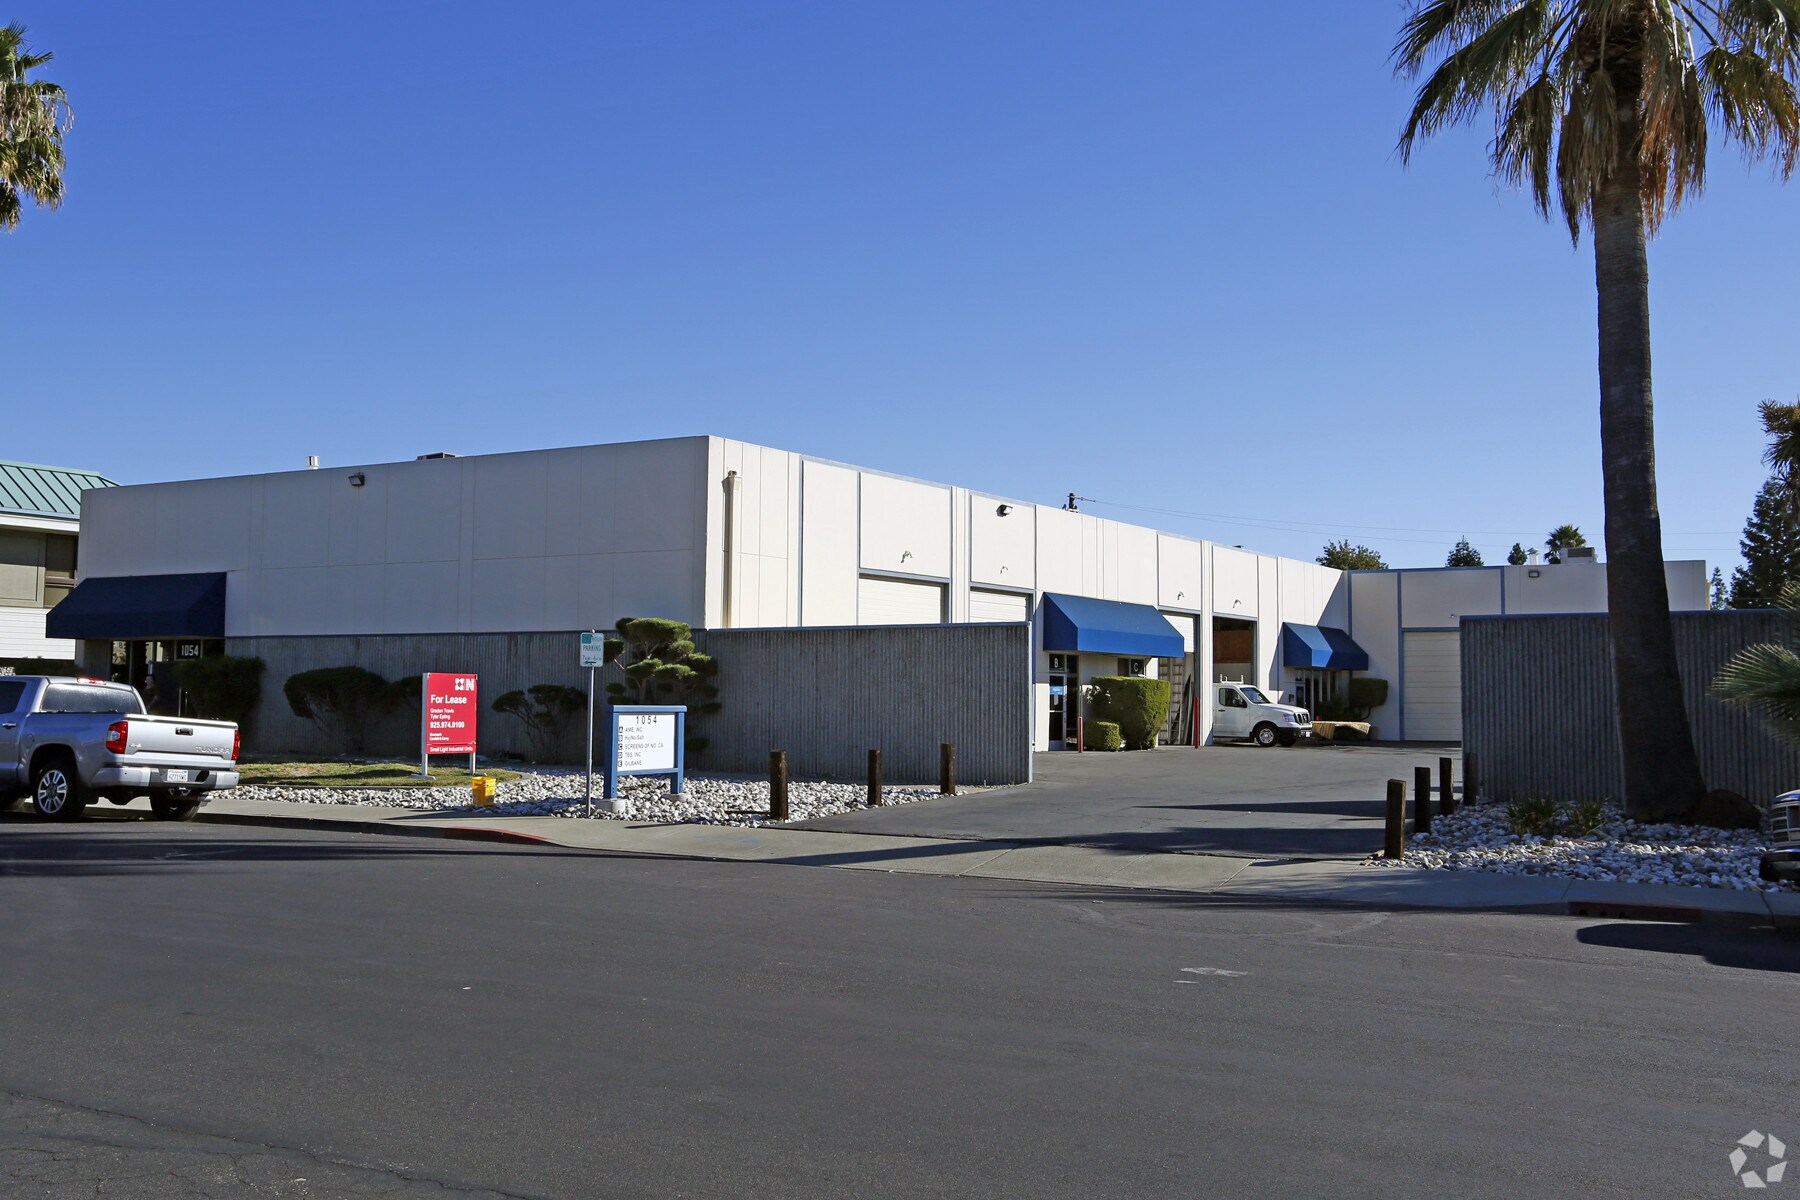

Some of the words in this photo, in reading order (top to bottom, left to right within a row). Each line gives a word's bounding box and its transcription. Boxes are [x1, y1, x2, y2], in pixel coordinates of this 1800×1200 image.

[181, 645, 199, 656] 1054
[1054, 658, 1059, 668] B
[1133, 662, 1139, 672] C
[430, 694, 444, 704] For
[445, 694, 467, 704] Lease
[636, 715, 657, 724] 1054
[195, 745, 231, 755] TUNDRA
